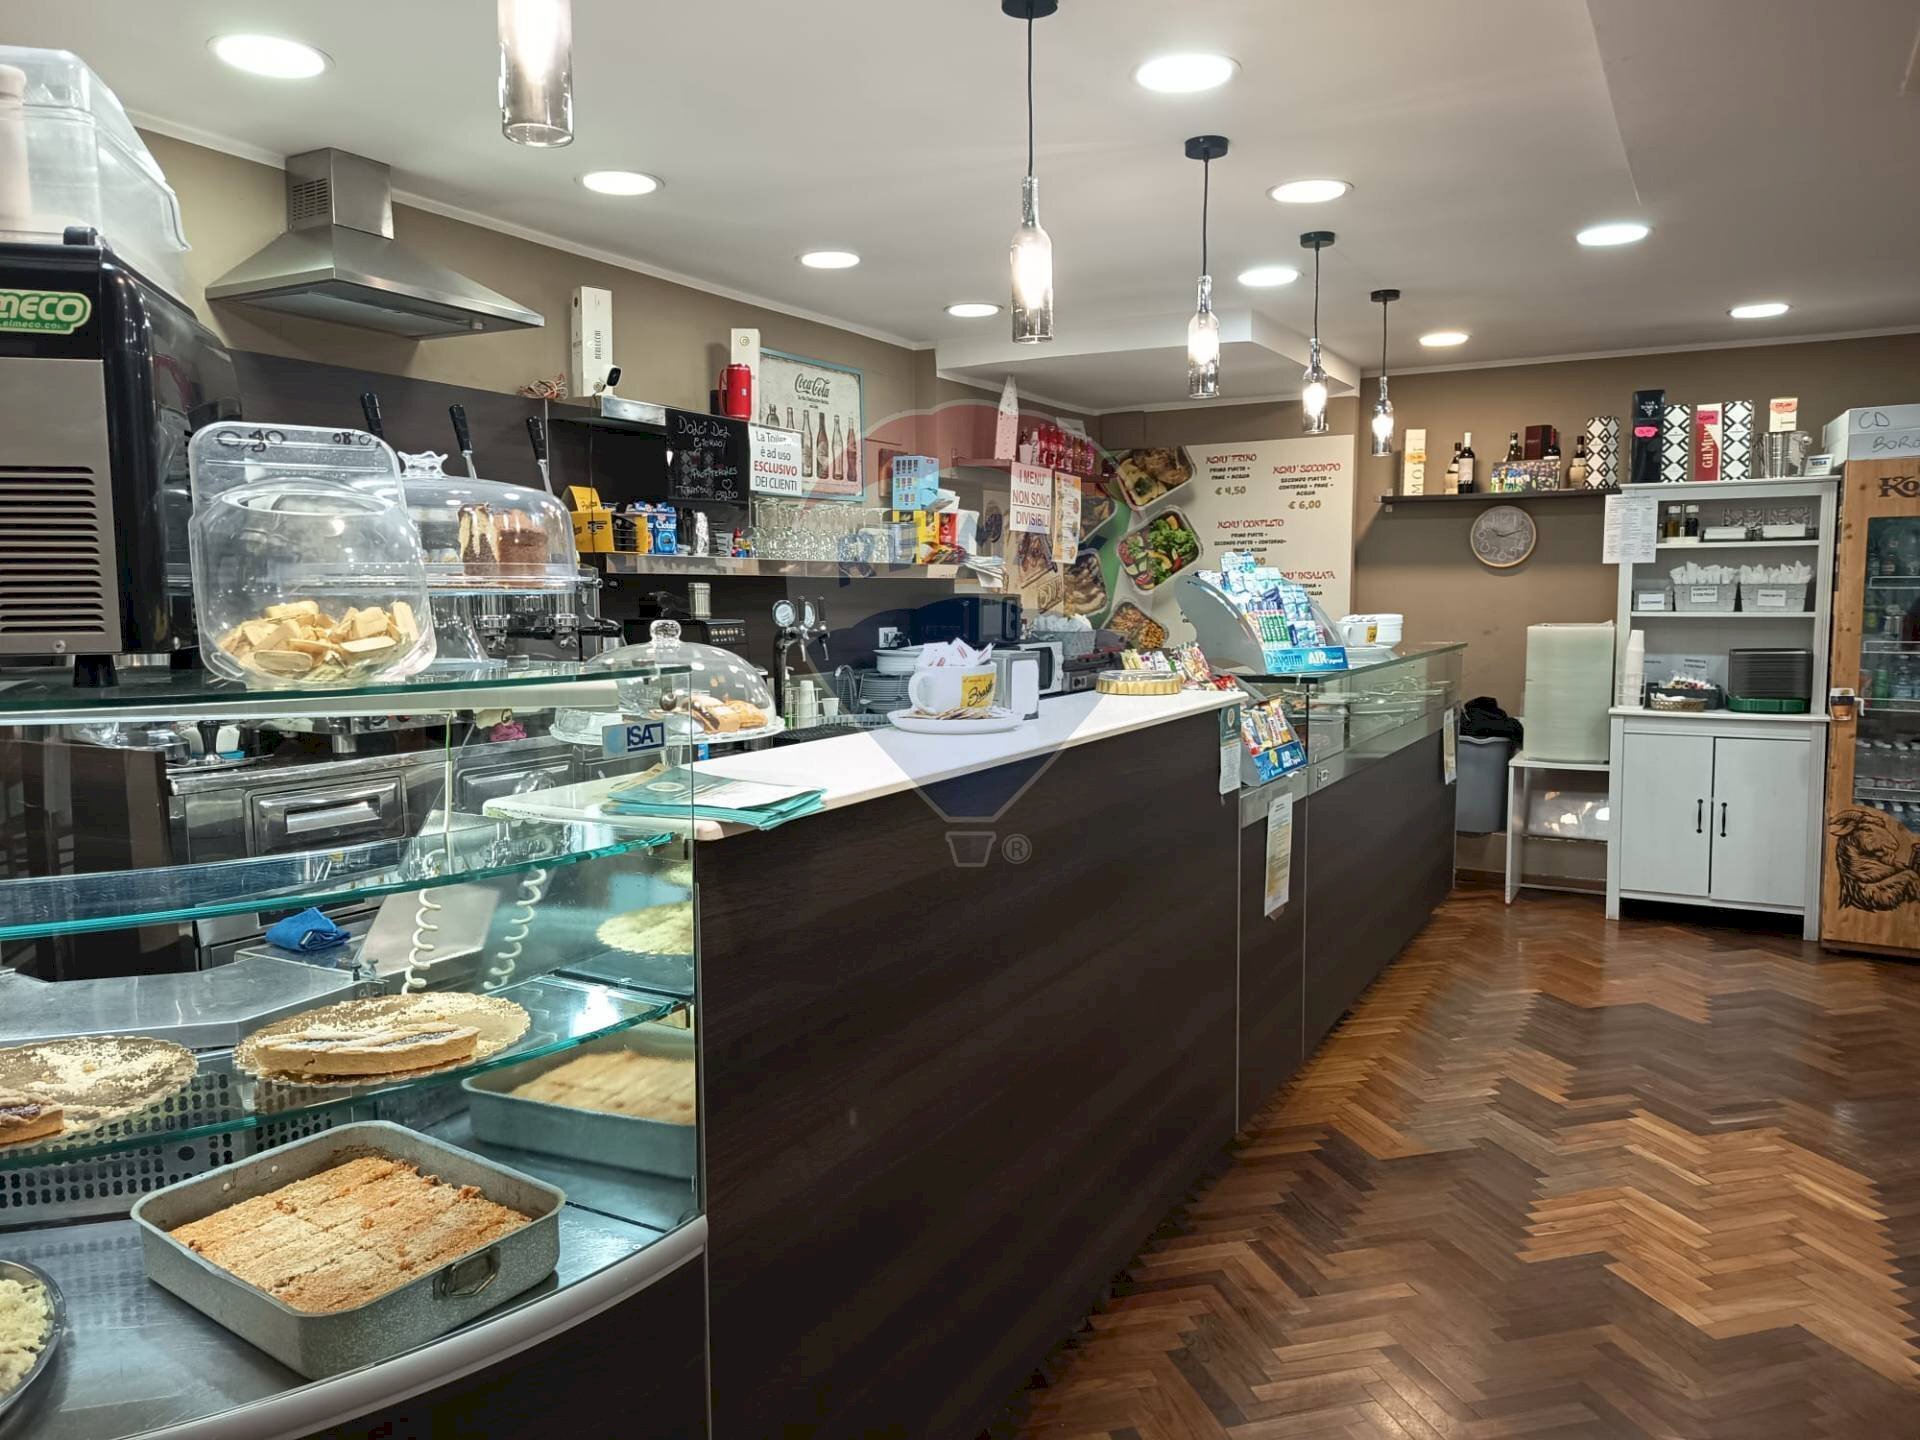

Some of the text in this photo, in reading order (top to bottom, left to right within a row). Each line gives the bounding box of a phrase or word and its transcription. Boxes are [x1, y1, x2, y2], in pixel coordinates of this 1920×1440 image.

[1858, 411, 1890, 429] CD
[755, 431, 766, 442] La
[767, 448, 777, 459] ad
[778, 451, 792, 461] uso
[754, 461, 798, 477] ESCLUSIVO
[755, 476, 798, 491] DEI CLIENTI
[1225, 486, 1247, 496] 4,50
[1877, 475, 1920, 498] Ko
[1012, 489, 1051, 508] NON SONO
[1299, 500, 1322, 511] 6,00
[1308, 650, 1327, 665] AIR
[626, 725, 655, 748] ISA
